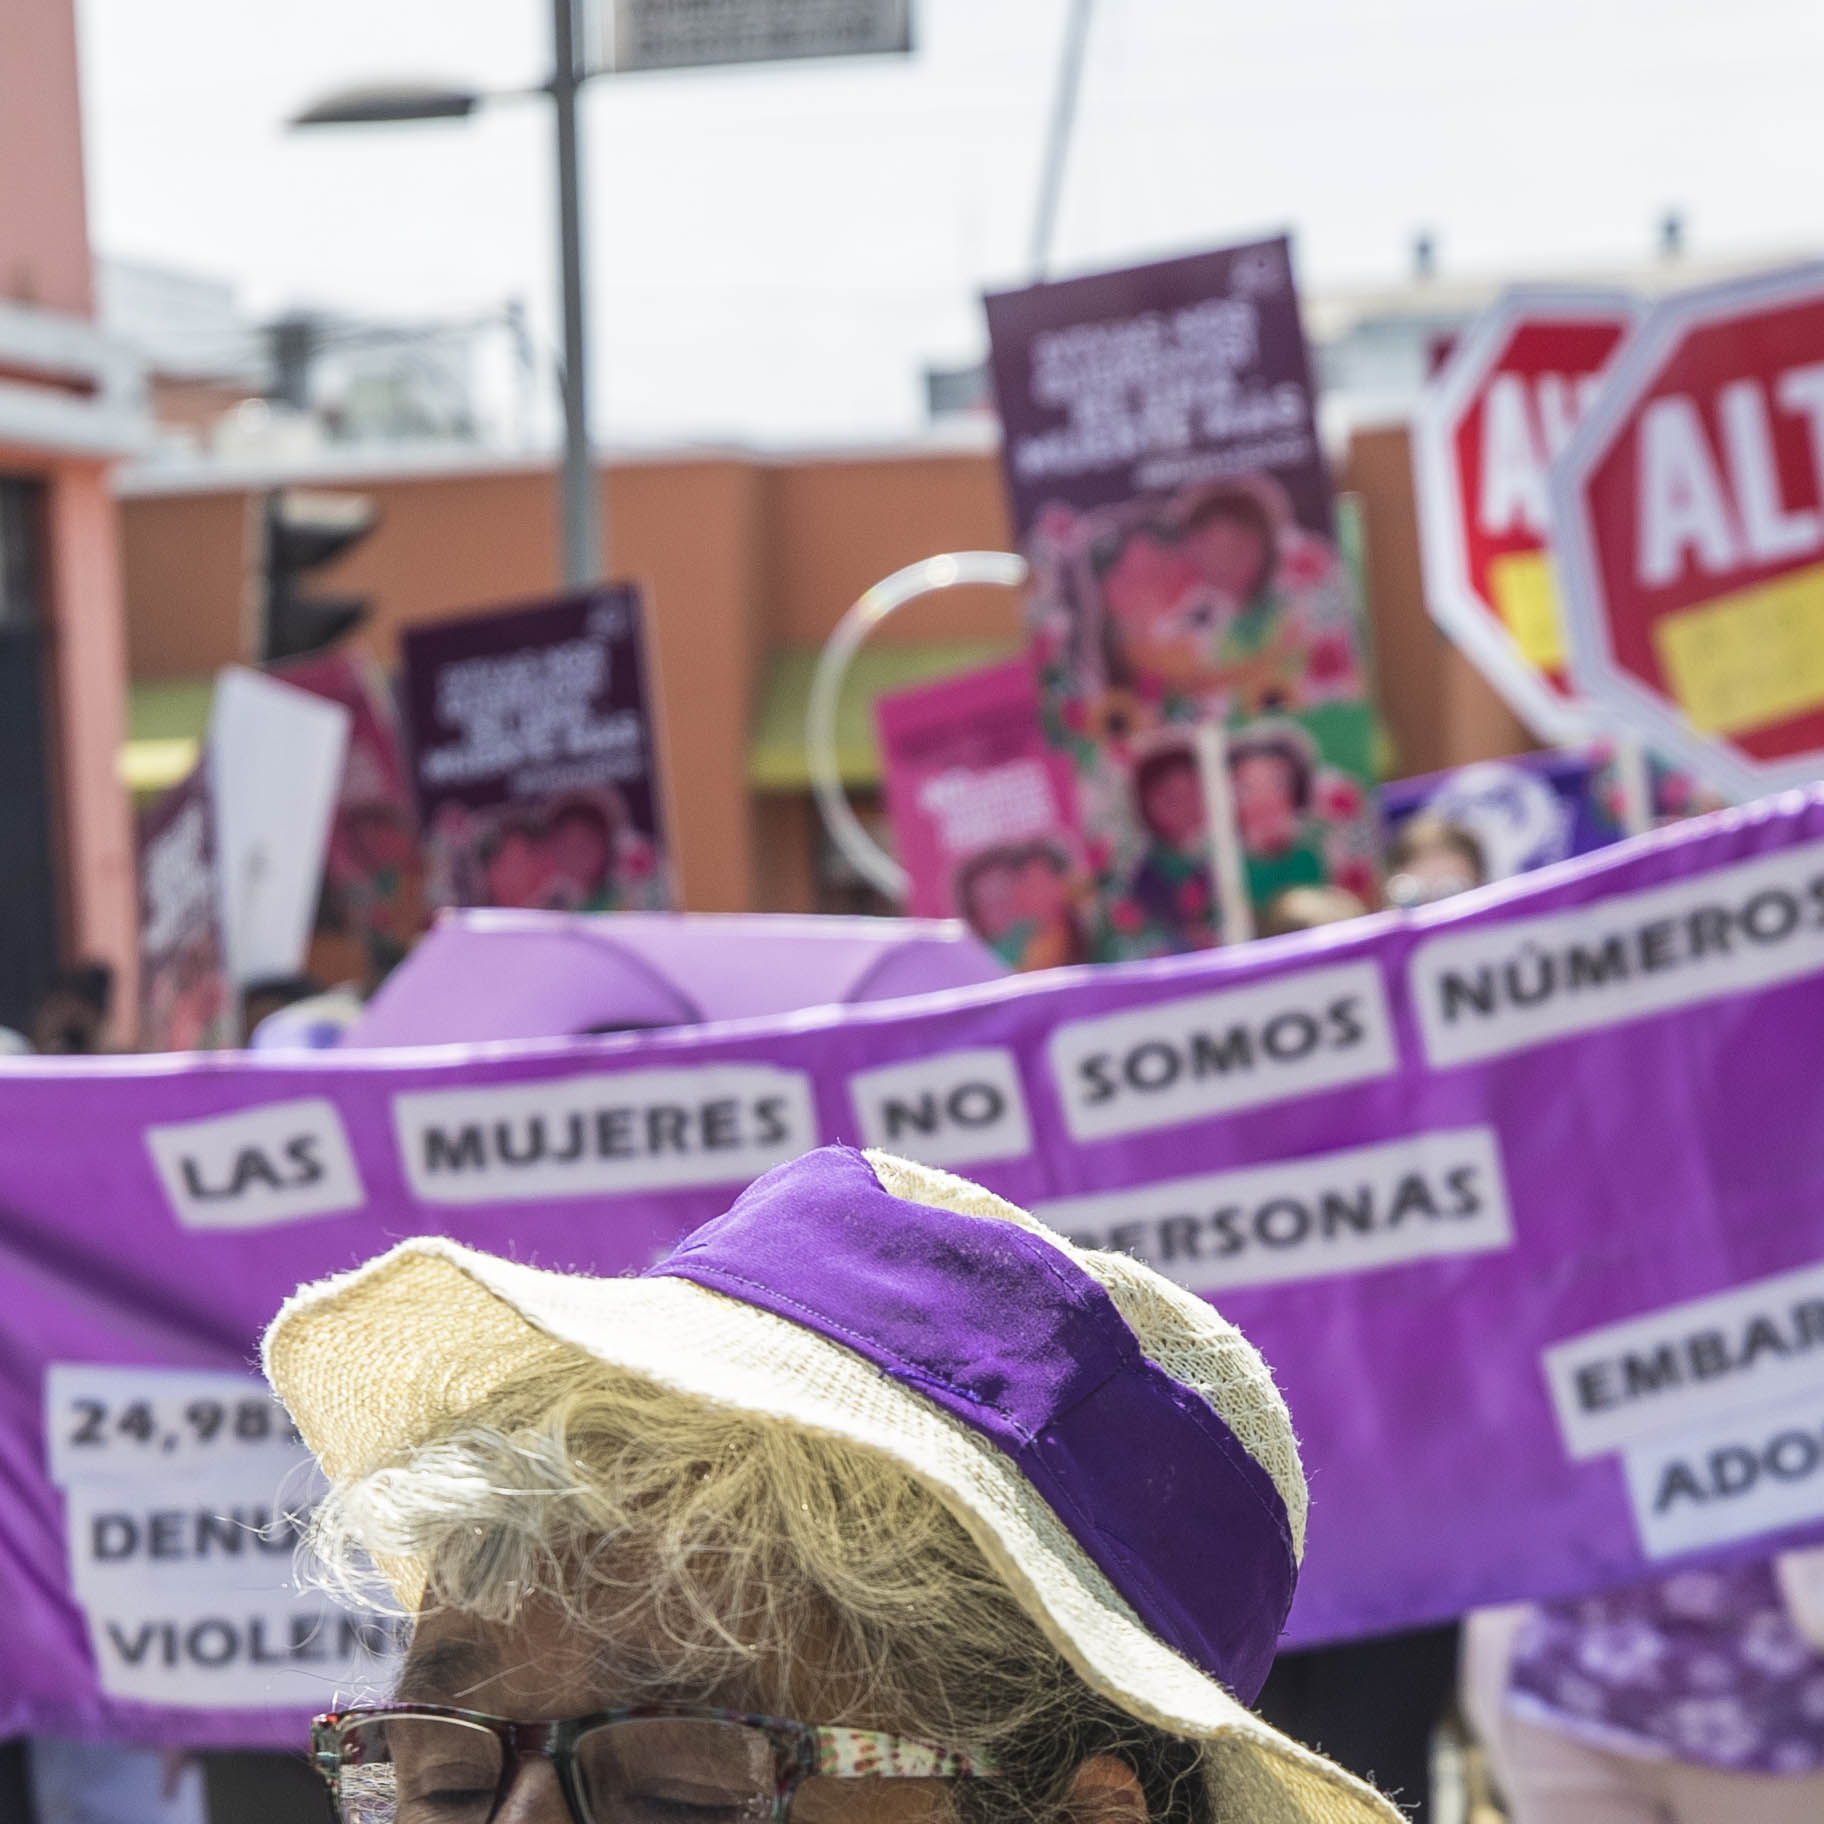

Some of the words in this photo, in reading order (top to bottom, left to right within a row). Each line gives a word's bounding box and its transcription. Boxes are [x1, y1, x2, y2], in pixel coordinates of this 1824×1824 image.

[180, 1132, 325, 1199] LAS
[422, 1095, 792, 1178] MUJERES
[882, 1080, 1006, 1141] NO
[1080, 994, 1367, 1107] SOMOS
[91, 1505, 300, 1562] DENU
